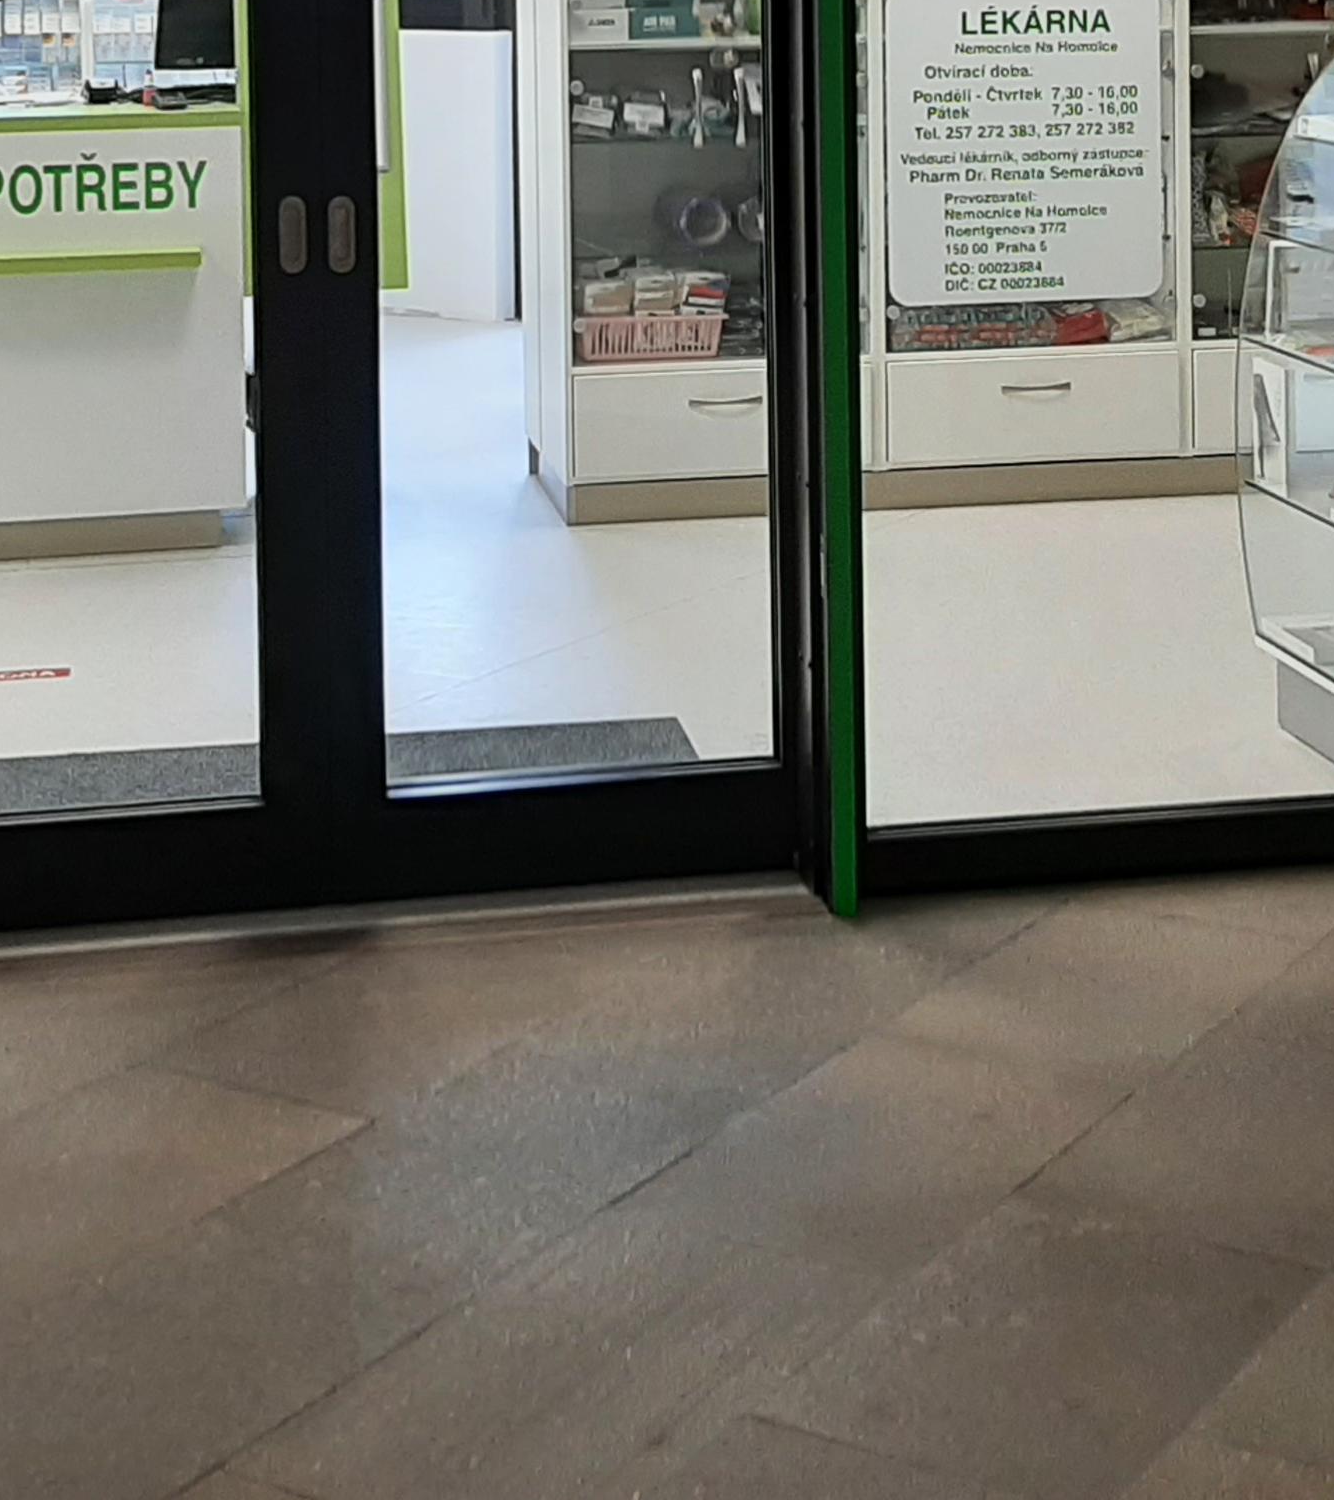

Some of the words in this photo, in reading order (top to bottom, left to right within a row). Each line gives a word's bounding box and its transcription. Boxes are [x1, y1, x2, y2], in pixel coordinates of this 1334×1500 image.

[961, 4, 1111, 35] LÉKÁRNA
[955, 43, 1031, 55] Nemocnice
[1036, 42, 1054, 53] Na
[987, 86, 1043, 102] Čtvrtek
[1051, 86, 1083, 102] 7,30
[1098, 85, 1138, 100] 16,00
[927, 106, 970, 120] Pátek
[1051, 103, 1083, 118] 7,30
[1099, 101, 1138, 117] 16,00
[915, 126, 941, 140] Tel.
[945, 125, 972, 139] 257
[977, 124, 1005, 138] 272
[1045, 123, 1071, 137] 257
[1076, 122, 1103, 136] 272
[909, 169, 960, 183] Pharm
[965, 168, 987, 182] Dr.
[991, 167, 1045, 182] Renata
[944, 207, 1021, 221] Nemocnice
[1025, 206, 1043, 219] Na
[945, 223, 1036, 239] Roentgenova
[946, 243, 969, 256] 150
[972, 242, 988, 255] 00
[996, 241, 1036, 254] Praha
[945, 261, 975, 275] IČO:
[945, 277, 974, 291] DIČ:
[977, 277, 997, 291] CZ
